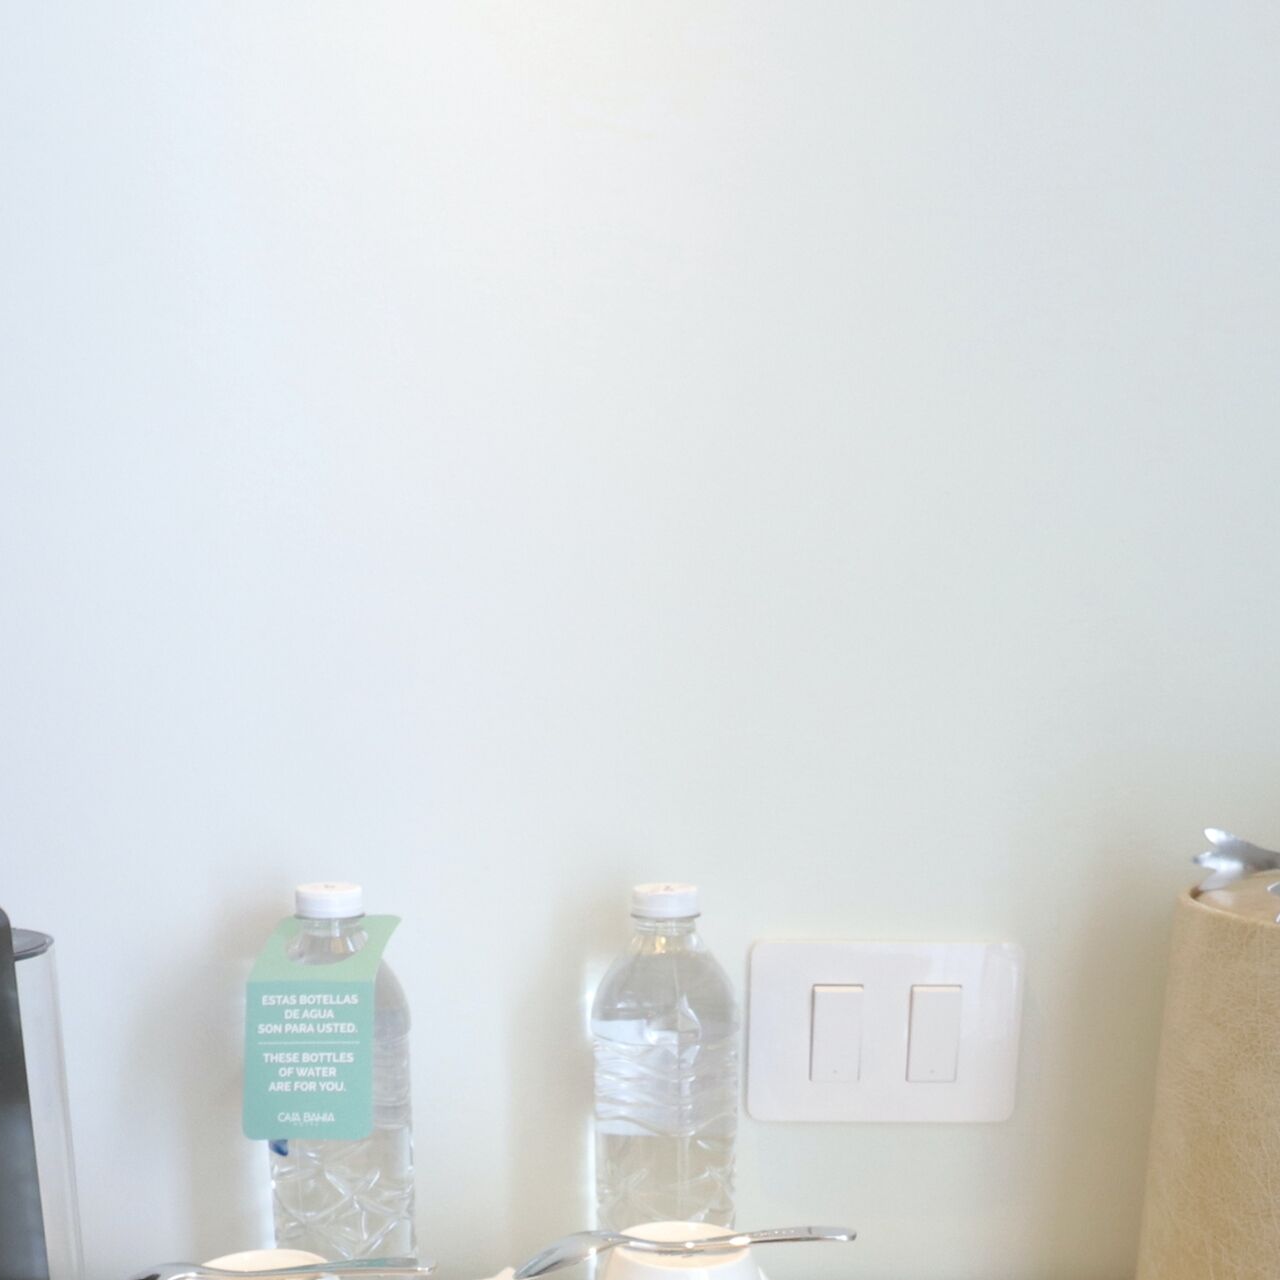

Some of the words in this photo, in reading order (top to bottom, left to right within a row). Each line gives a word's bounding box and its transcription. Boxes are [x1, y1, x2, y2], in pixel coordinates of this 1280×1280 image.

[261, 994, 297, 1006] ESTAS
[299, 994, 359, 1005] BOTELLAS
[284, 1009, 300, 1020] DE
[302, 1009, 335, 1019] AGUA
[257, 1023, 282, 1034] SON
[284, 1023, 314, 1034] PARA
[316, 1022, 358, 1034] USTED.
[263, 1053, 301, 1063] THESE
[302, 1052, 354, 1063] BOTTLES
[278, 1067, 294, 1077] OF
[295, 1066, 337, 1077] WATER
[269, 1081, 291, 1092] ARE
[294, 1081, 317, 1092] FOR
[319, 1081, 347, 1092] YOU.
